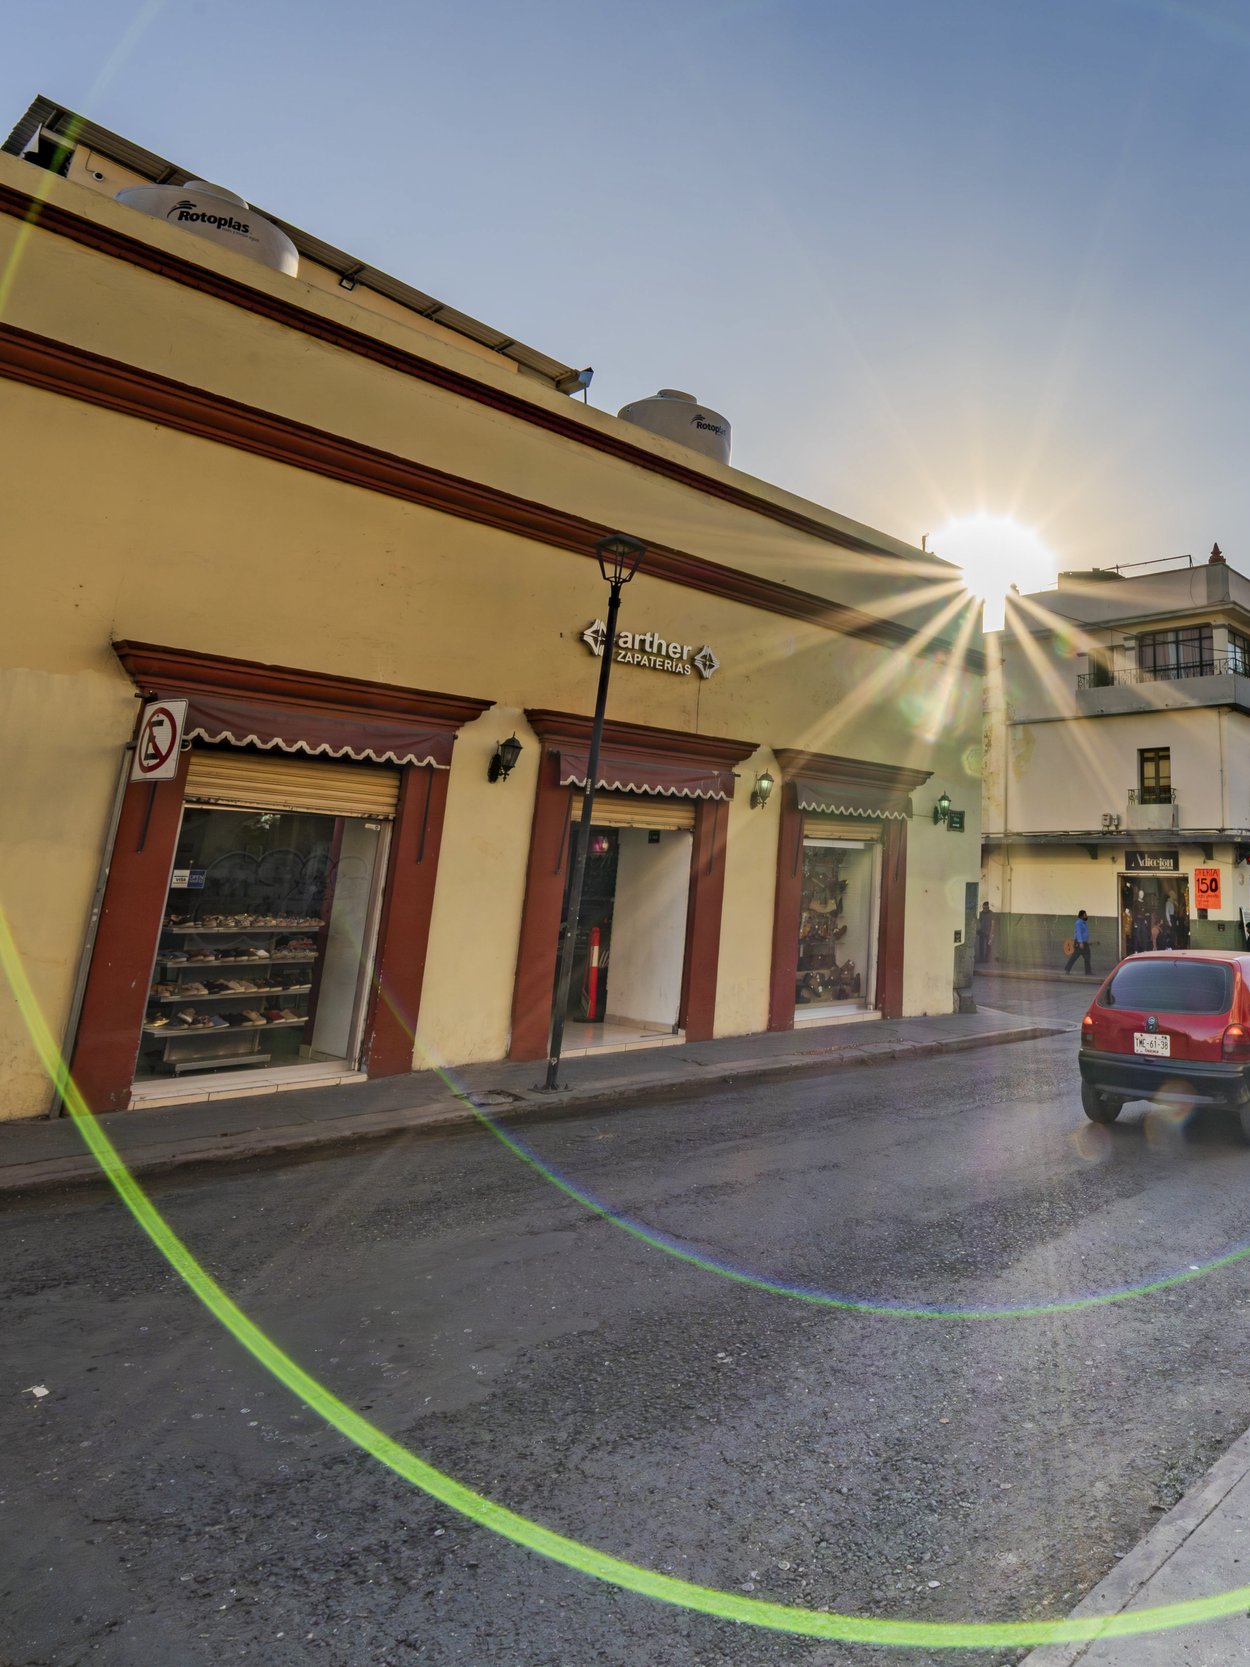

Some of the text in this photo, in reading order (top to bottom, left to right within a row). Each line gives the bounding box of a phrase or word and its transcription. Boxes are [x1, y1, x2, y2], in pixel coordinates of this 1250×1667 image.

[178, 210, 250, 234] Rotoplas
[618, 631, 692, 660] arther
[617, 650, 691, 675] ZAPATERÍAS
[1196, 877, 1219, 894] 150
